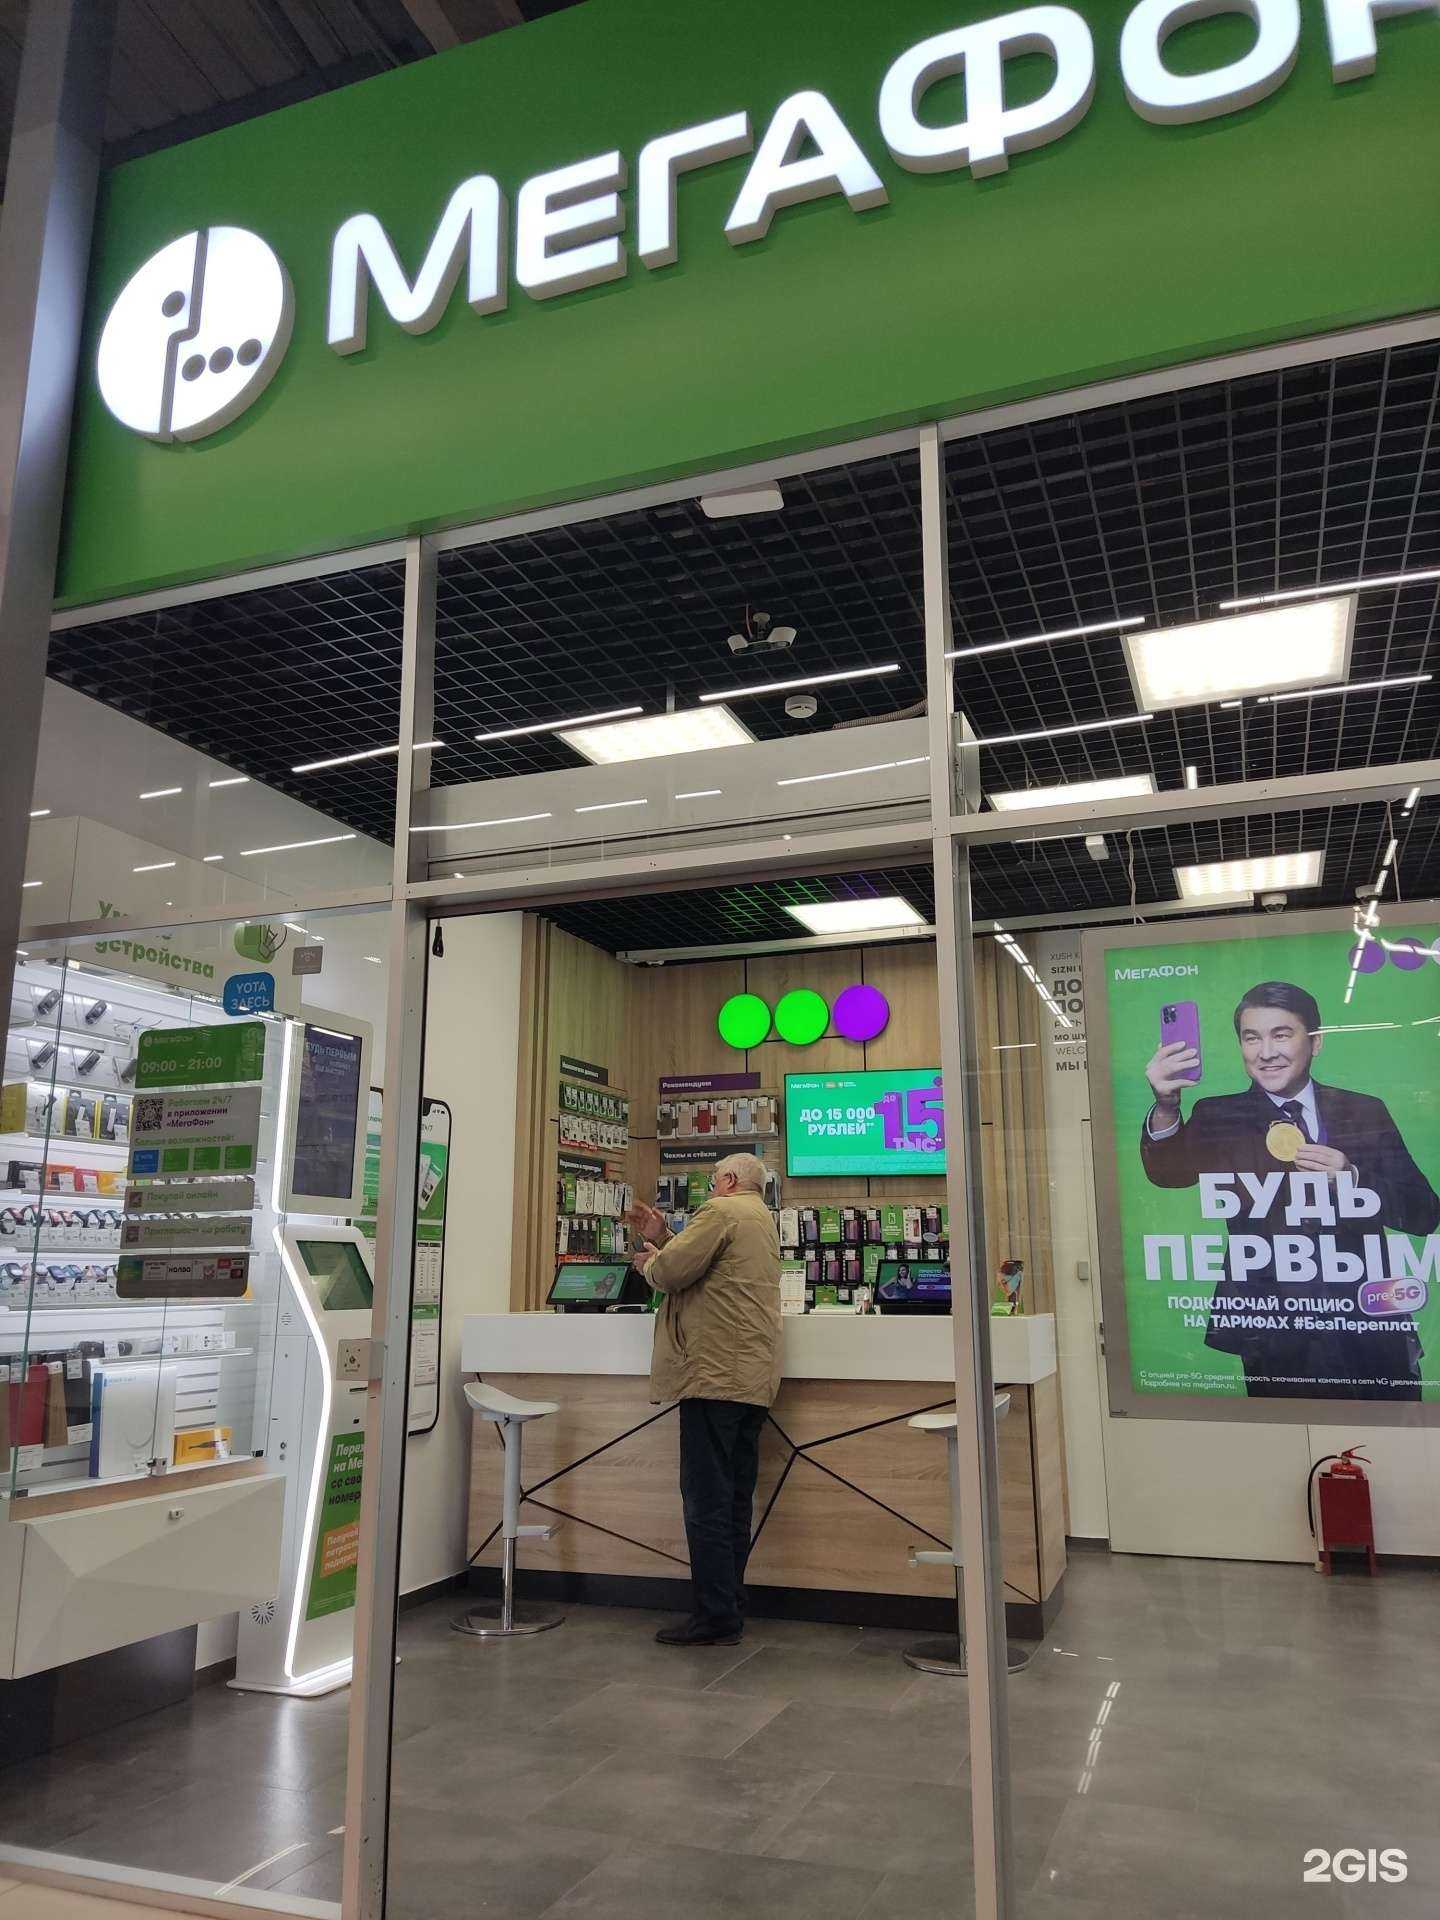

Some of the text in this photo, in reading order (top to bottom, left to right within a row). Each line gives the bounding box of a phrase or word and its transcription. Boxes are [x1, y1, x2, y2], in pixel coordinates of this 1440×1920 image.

[94, 939, 215, 978] устройства
[236, 980, 268, 994] YOTA
[230, 995, 271, 1010] ЗДЕСЬ
[141, 1060, 177, 1074] 09:00
[188, 1057, 223, 1071] 21:00
[662, 1081, 712, 1089] Рекомендуем
[174, 1107, 228, 1119] приложении
[800, 1107, 875, 1122] ДО 15 000
[166, 1118, 214, 1129] «МегаФон»
[1199, 1171, 1382, 1226] БУДЬ
[1143, 1233, 1440, 1283] ПЕРВЫМ
[1168, 1295, 1279, 1312] ПОДКЛЮЧАЙ
[1284, 1297, 1354, 1314] ОПЦИЮ
[1184, 1314, 1420, 1334] НА ТАРИФАХ #БезПереплат
[1237, 1375, 1270, 1383] скорость
[1376, 1377, 1389, 1386] 4G
[333, 1462, 347, 1473] на
